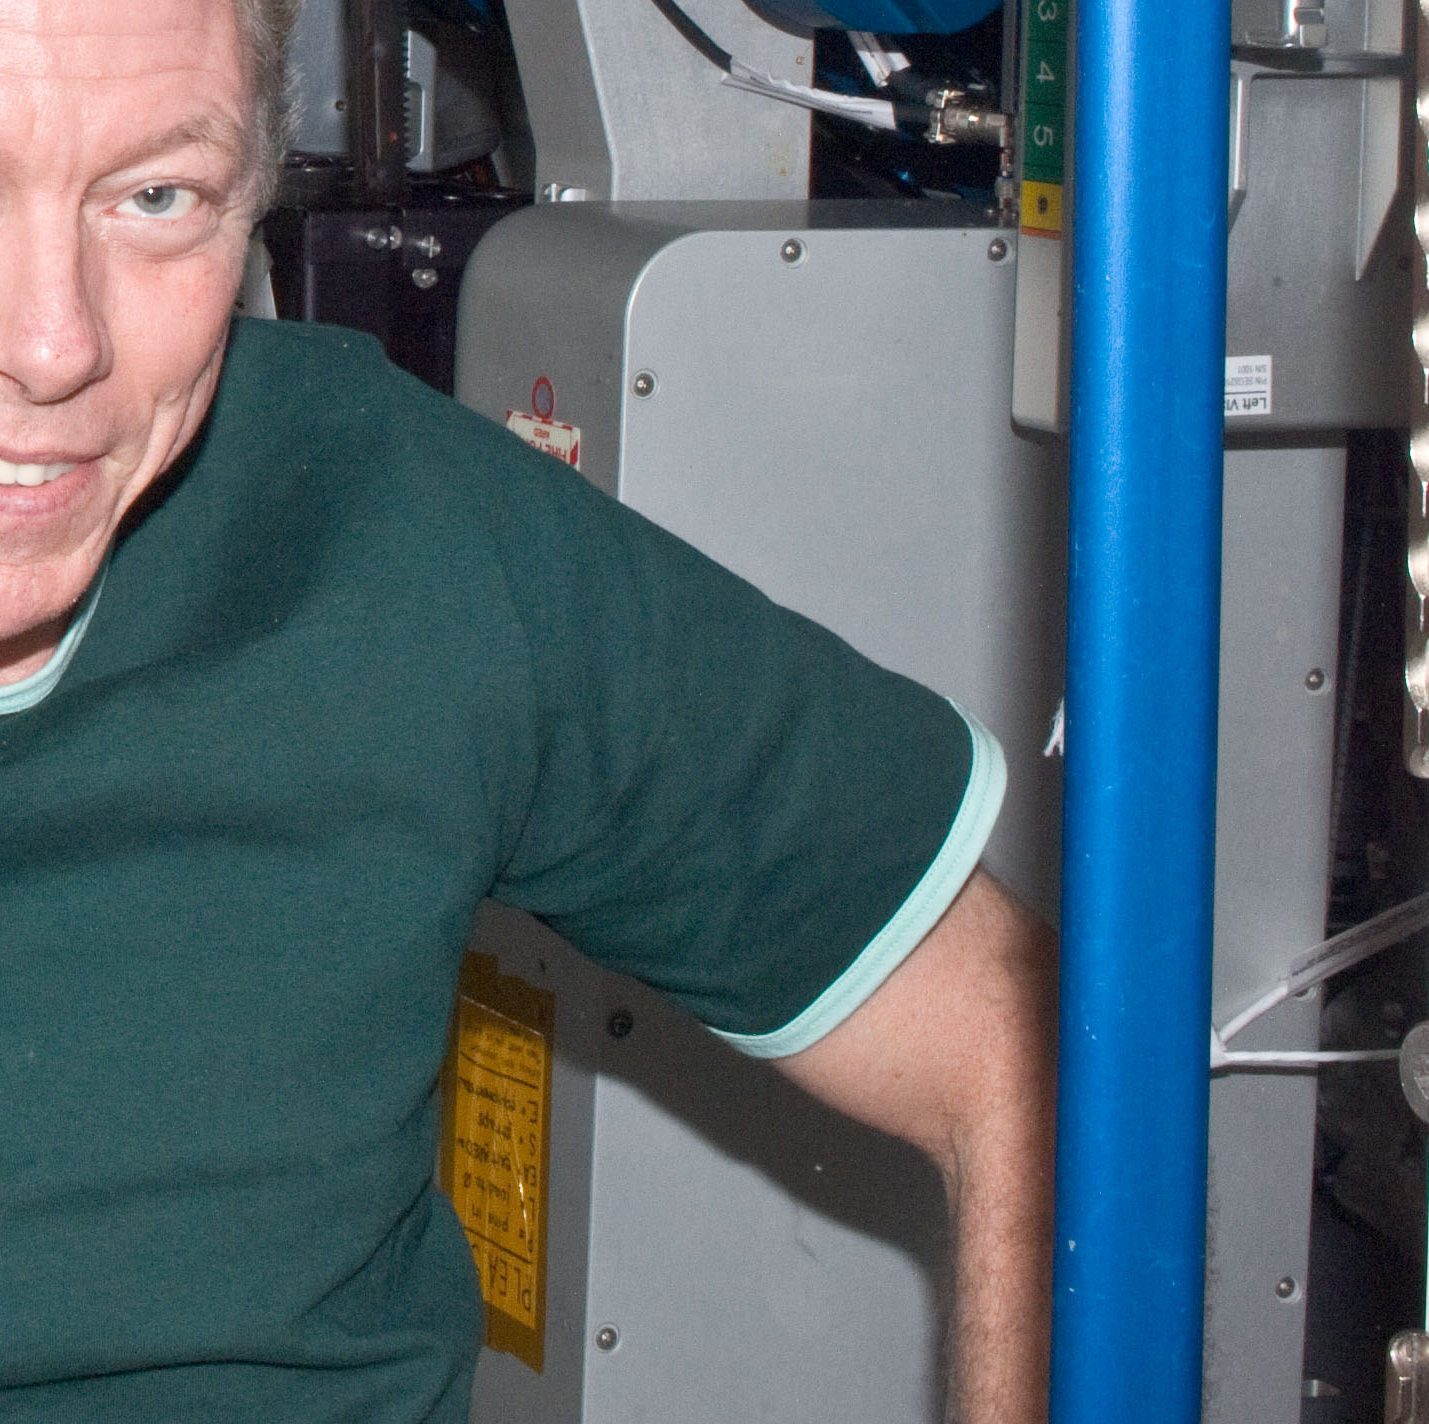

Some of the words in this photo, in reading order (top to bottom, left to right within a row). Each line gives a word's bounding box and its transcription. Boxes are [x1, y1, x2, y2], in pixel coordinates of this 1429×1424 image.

[1037, 0, 1057, 21] 3
[1035, 61, 1055, 83] 4
[1033, 124, 1053, 147] 5
[1226, 399, 1240, 411] VI
[1243, 397, 1267, 411] Left
